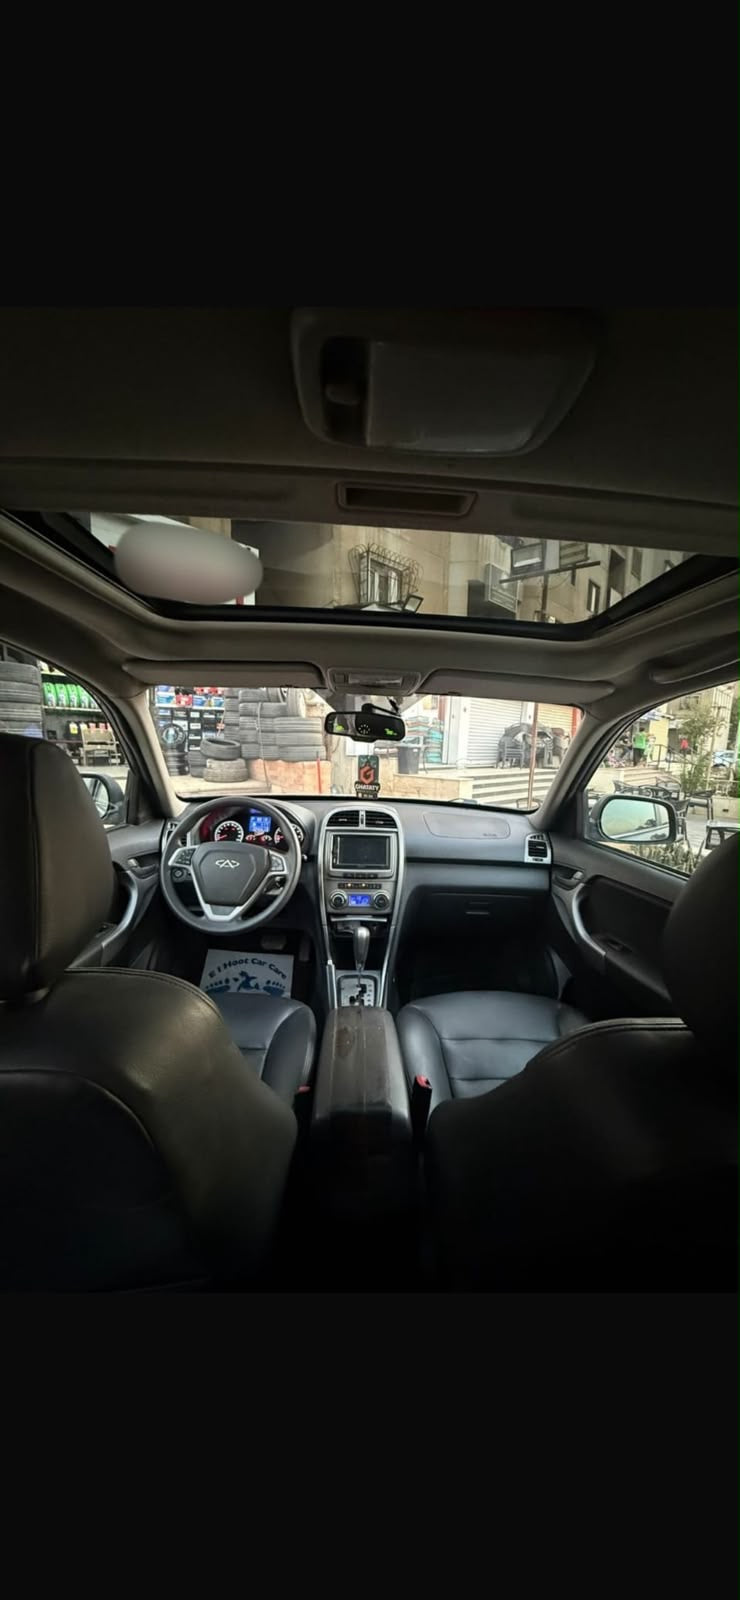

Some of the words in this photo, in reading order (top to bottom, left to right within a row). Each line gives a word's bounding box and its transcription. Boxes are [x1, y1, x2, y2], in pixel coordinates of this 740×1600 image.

[223, 958, 249, 969] Hoot
[251, 958, 267, 966] Car
[268, 963, 287, 979] Care
